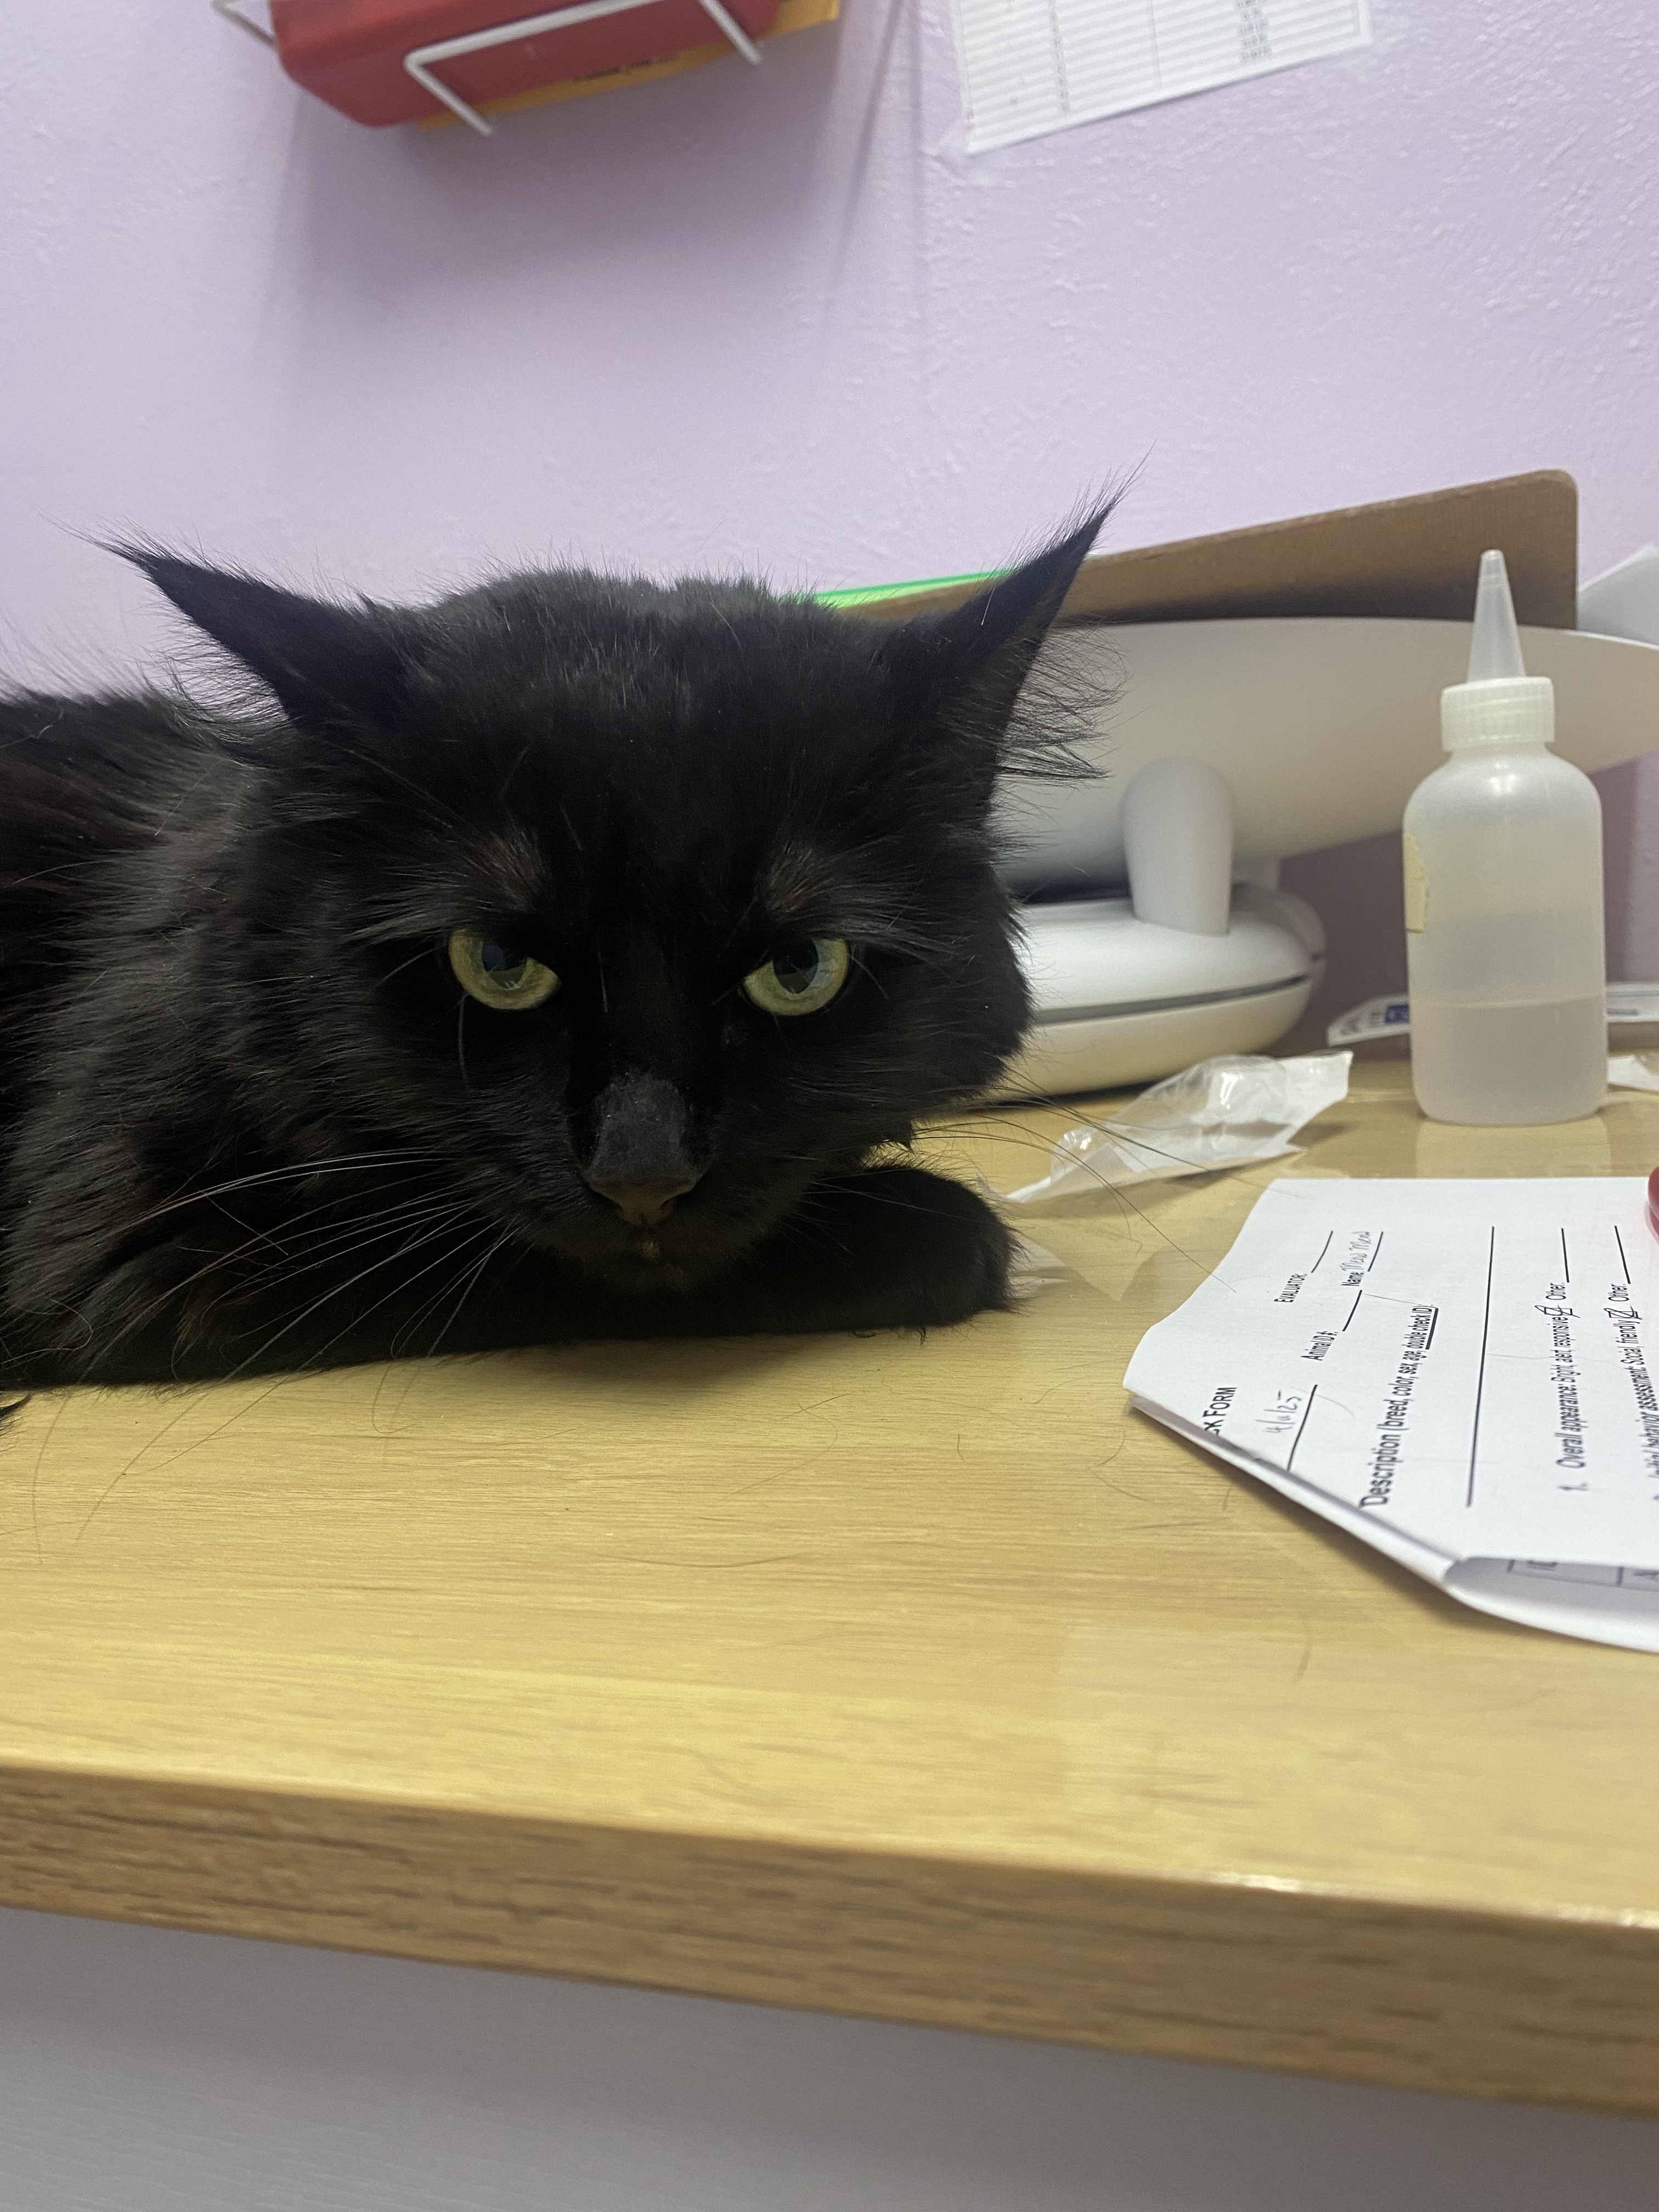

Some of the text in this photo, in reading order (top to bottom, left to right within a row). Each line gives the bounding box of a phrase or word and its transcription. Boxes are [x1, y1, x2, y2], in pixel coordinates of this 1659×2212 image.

[1408, 1314, 1431, 1331] check
[1547, 1317, 1576, 1348] responsive
[1613, 1320, 1641, 1344] friendly
[1301, 1342, 1333, 1361] Animal
[1401, 1332, 1427, 1349] double
[1402, 1351, 1427, 1361] age,
[1618, 1346, 1645, 1365] Social,
[1398, 1362, 1423, 1374] sex,
[1550, 1364, 1581, 1383] Bright,
[1388, 1376, 1419, 1396] color,
[1624, 1366, 1658, 1411] assessment:
[1203, 1387, 1237, 1417] FORM
[1558, 1384, 1589, 1432] appearance:
[1376, 1399, 1414, 1430] (breed,
[1555, 1432, 1586, 1468] Overall
[1359, 1434, 1404, 1508] Description
